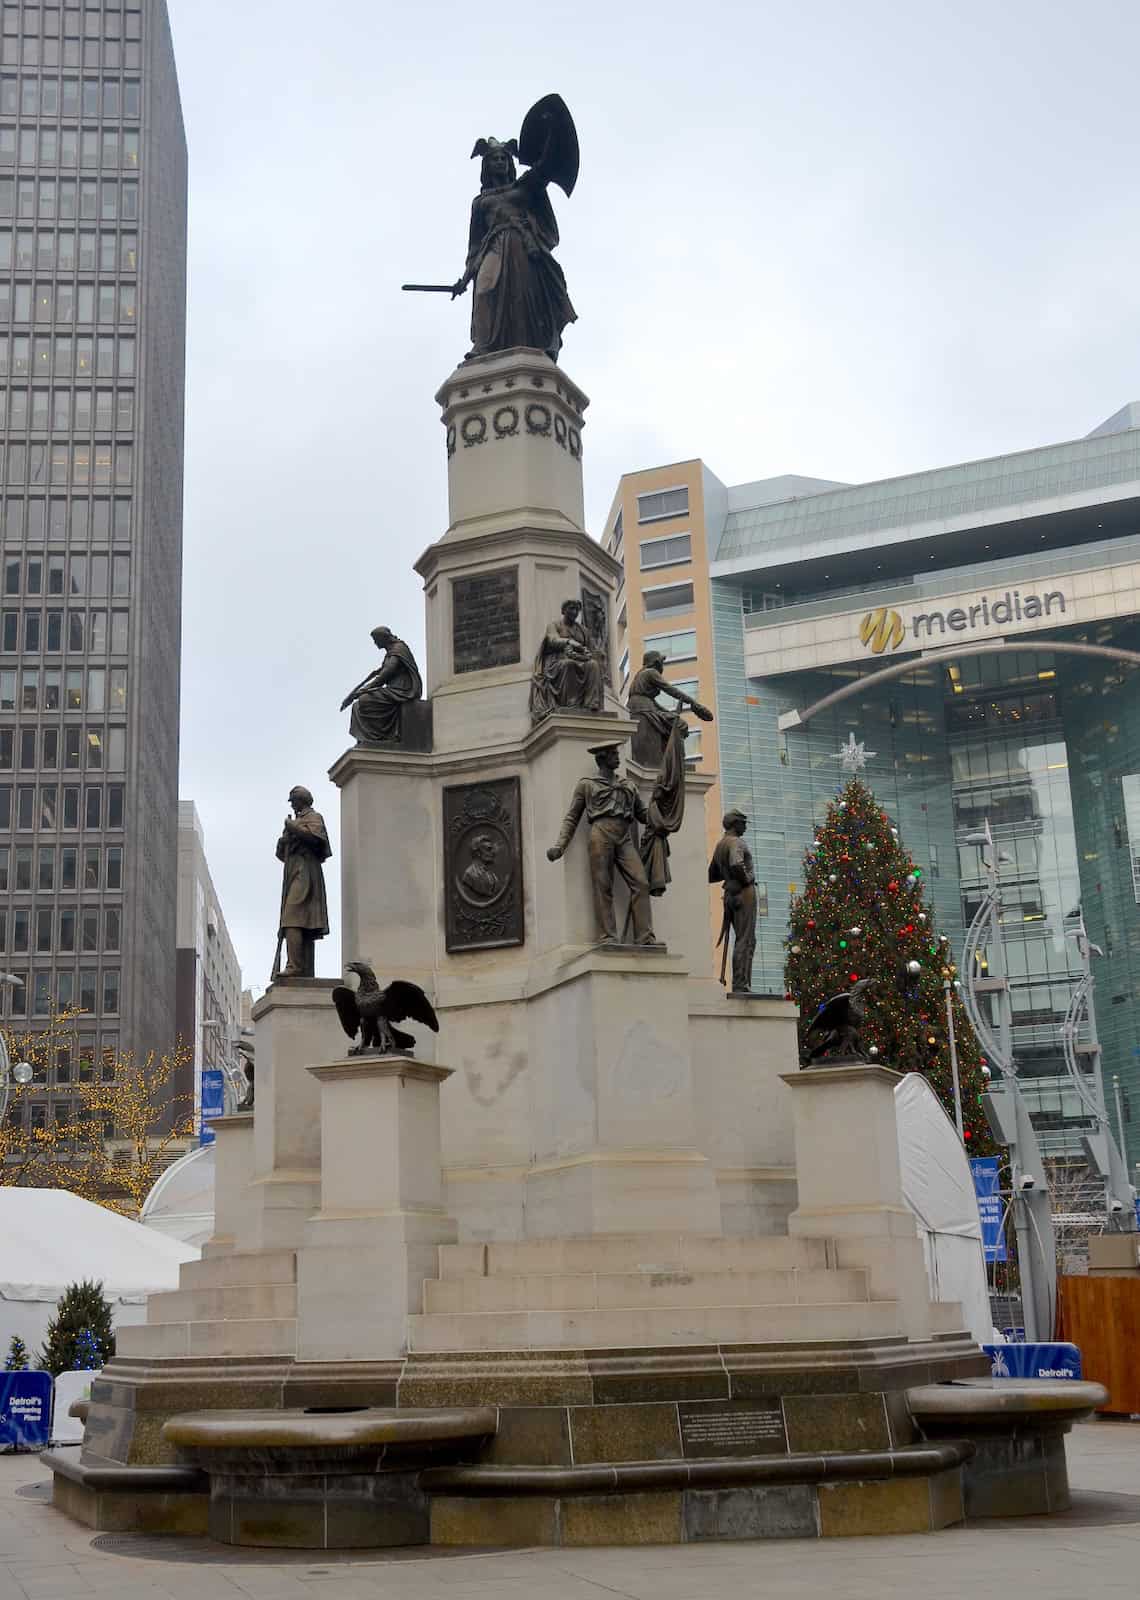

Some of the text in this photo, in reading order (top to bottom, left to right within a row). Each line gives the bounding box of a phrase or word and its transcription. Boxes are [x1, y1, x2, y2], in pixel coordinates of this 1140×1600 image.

[912, 590, 1066, 637] meridian
[1038, 1368, 1074, 1377] Detroit's
[9, 1396, 42, 1406] Detroit's
